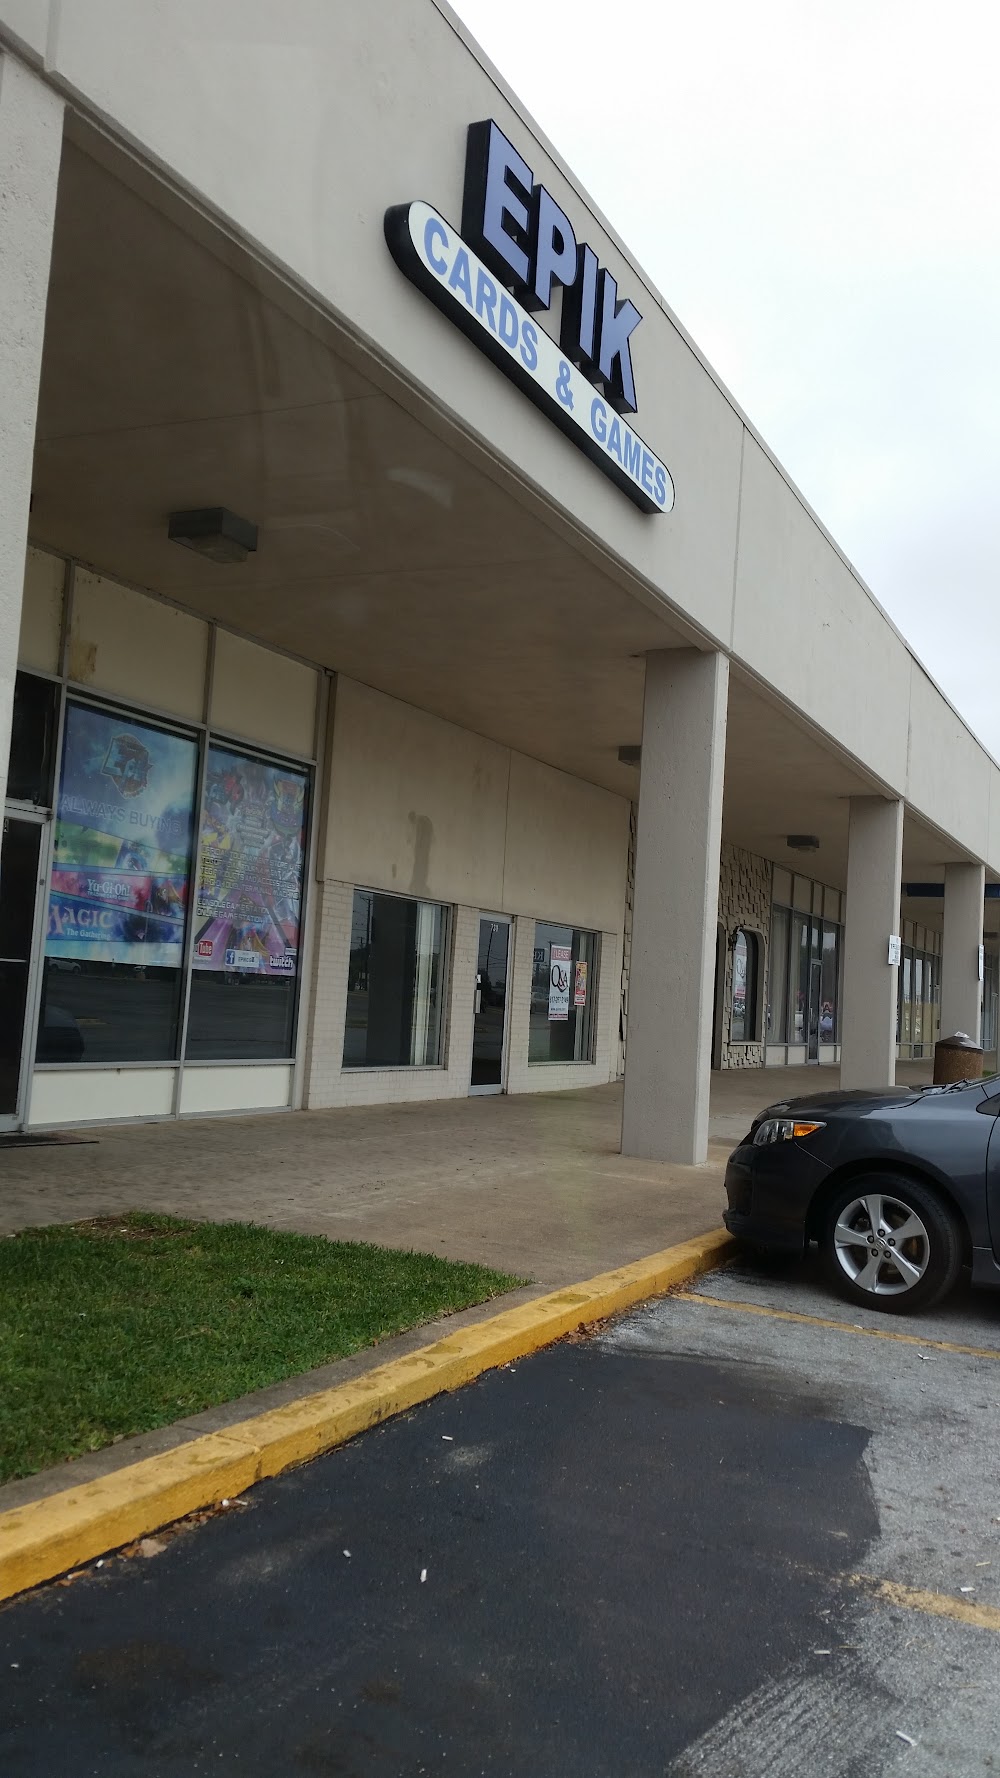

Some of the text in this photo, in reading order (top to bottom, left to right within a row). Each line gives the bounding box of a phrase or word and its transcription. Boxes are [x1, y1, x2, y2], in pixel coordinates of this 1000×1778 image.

[480, 119, 643, 414] EPIK
[423, 218, 666, 505] CARDS & GAMES
[61, 794, 182, 833] ALWAYS BUYING
[270, 860, 288, 869] STORE
[87, 879, 130, 896] Yu-Gi-Oh!
[67, 928, 78, 937] The
[556, 949, 569, 960] LEASE
[269, 956, 294, 968] twitch
